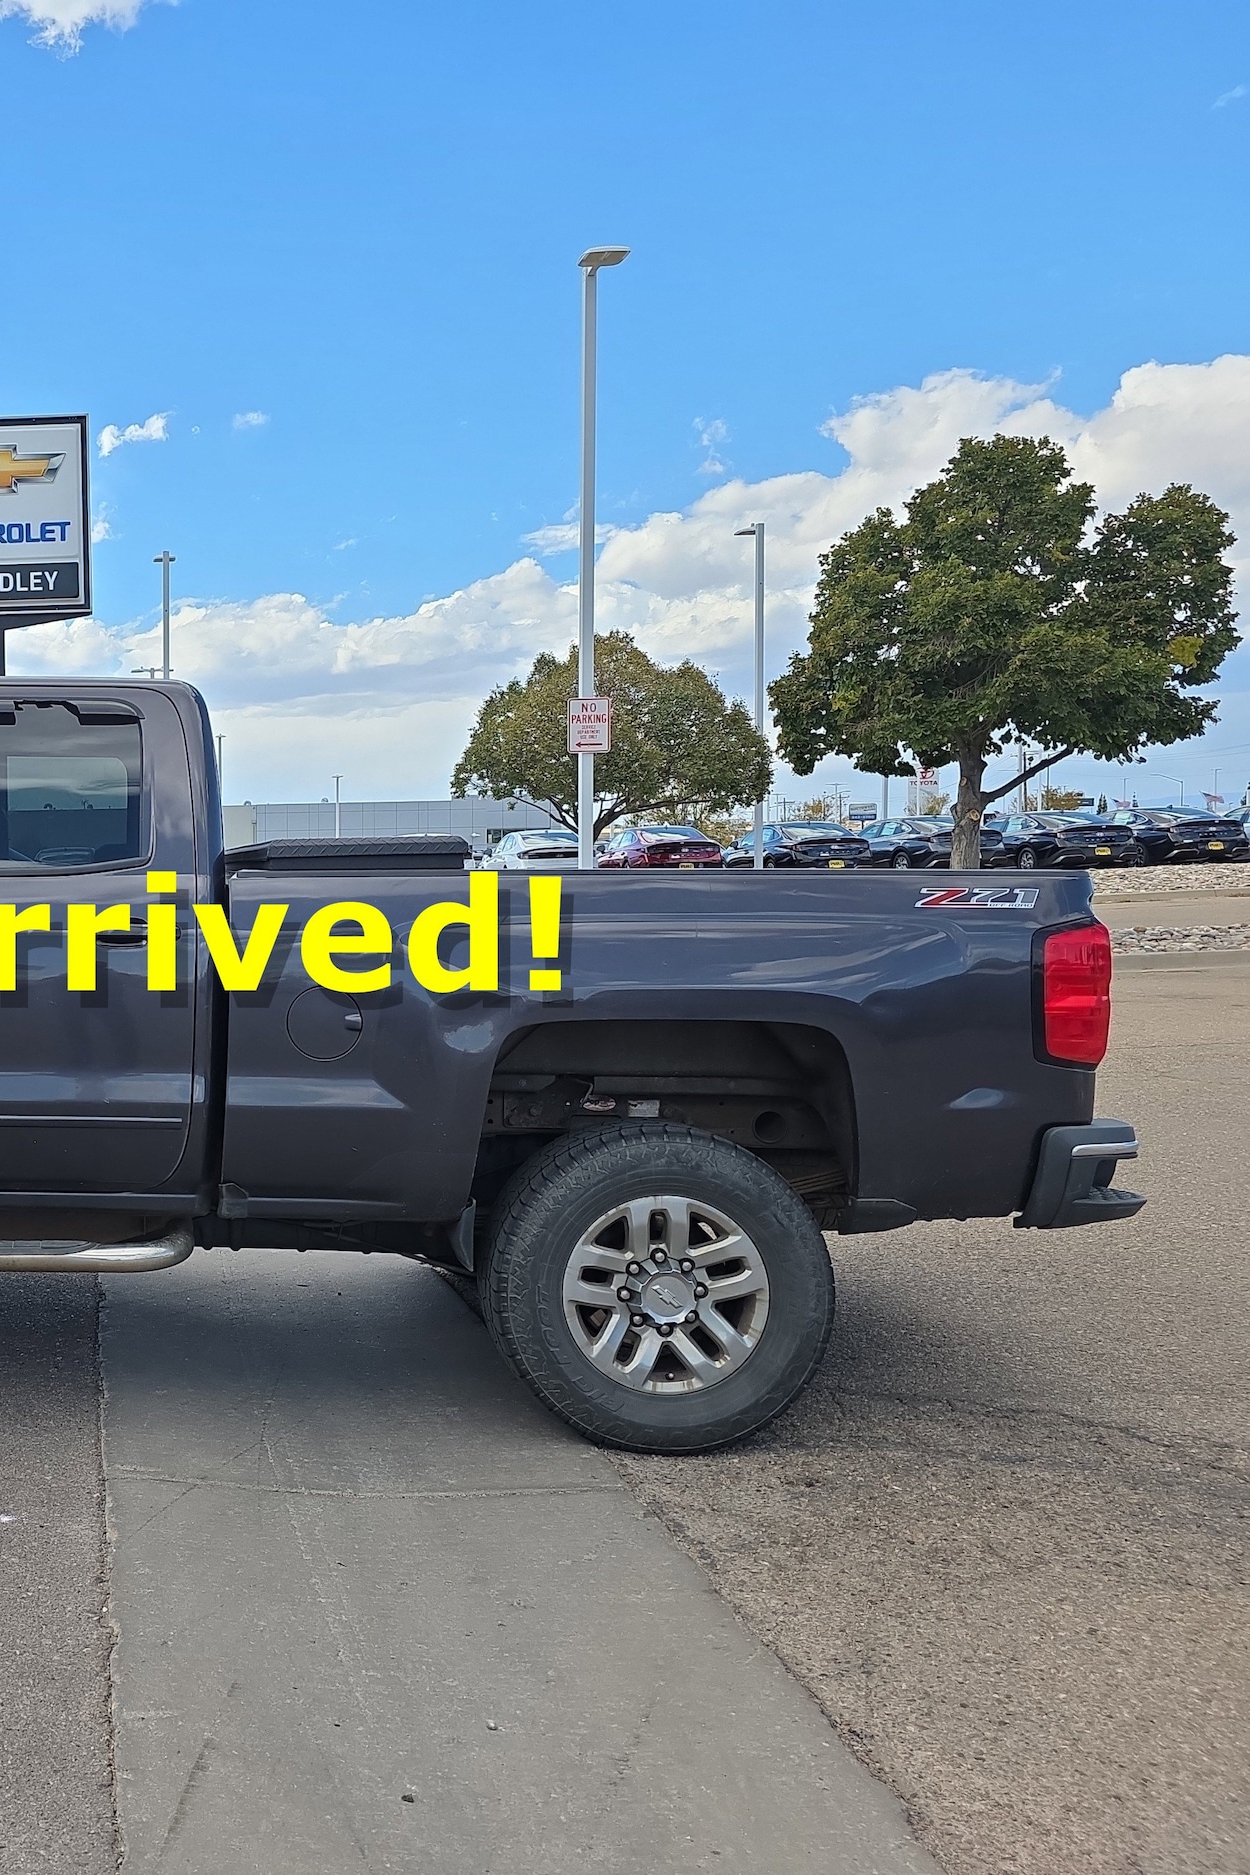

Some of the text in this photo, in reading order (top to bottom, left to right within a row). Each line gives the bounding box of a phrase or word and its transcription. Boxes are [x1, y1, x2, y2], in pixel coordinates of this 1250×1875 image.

[582, 703, 596, 712] NO
[571, 714, 607, 724] PARKING
[914, 887, 1040, 909] Z71
